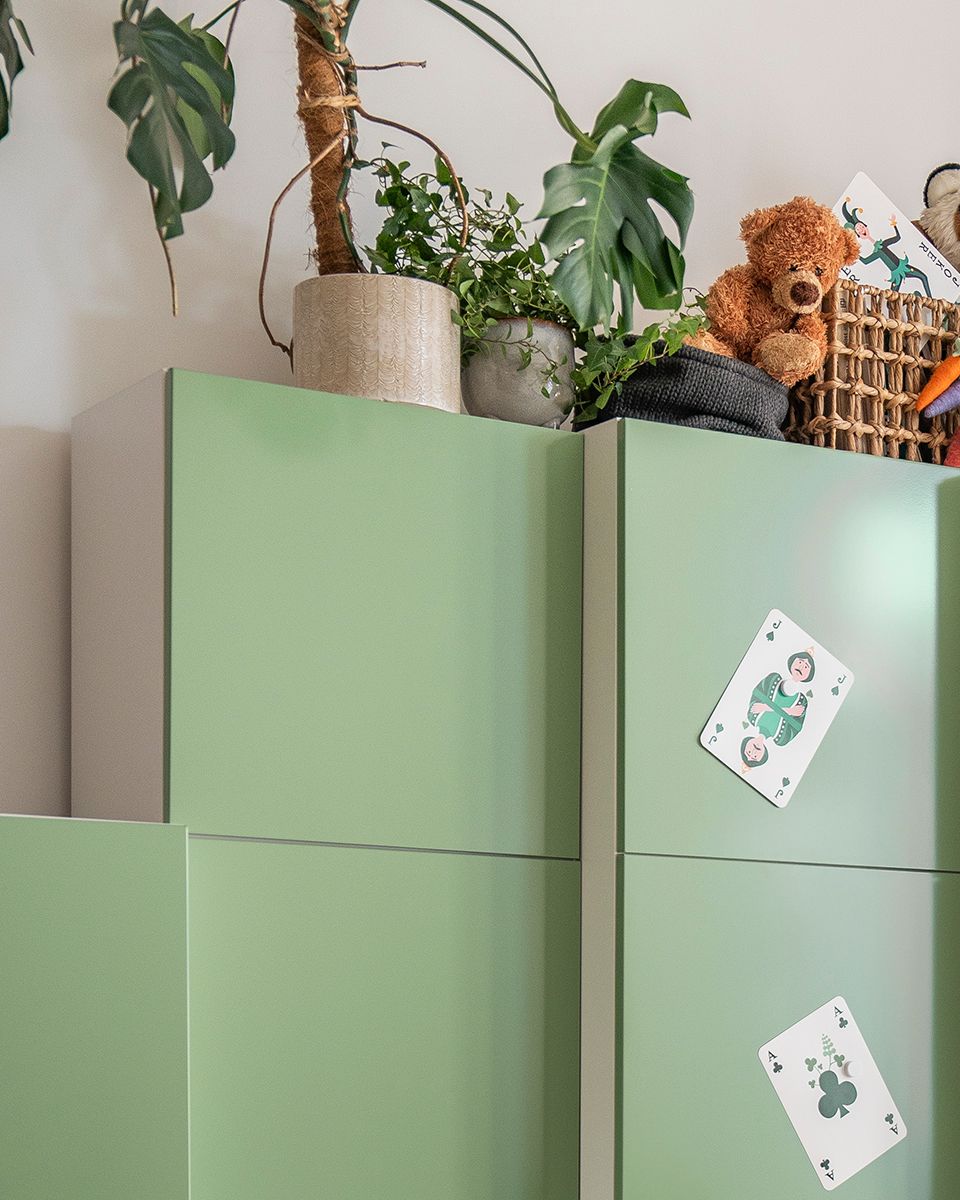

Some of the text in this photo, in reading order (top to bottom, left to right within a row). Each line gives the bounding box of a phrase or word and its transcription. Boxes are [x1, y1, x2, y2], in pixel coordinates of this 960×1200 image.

[917, 241, 960, 288] JOKER
[773, 619, 783, 630] J
[837, 674, 847, 684] J
[708, 735, 718, 745] J
[775, 789, 784, 799] J
[834, 1006, 844, 1017] A
[767, 1050, 778, 1062] A
[889, 1124, 899, 1135] A
[825, 1169, 835, 1181] A
